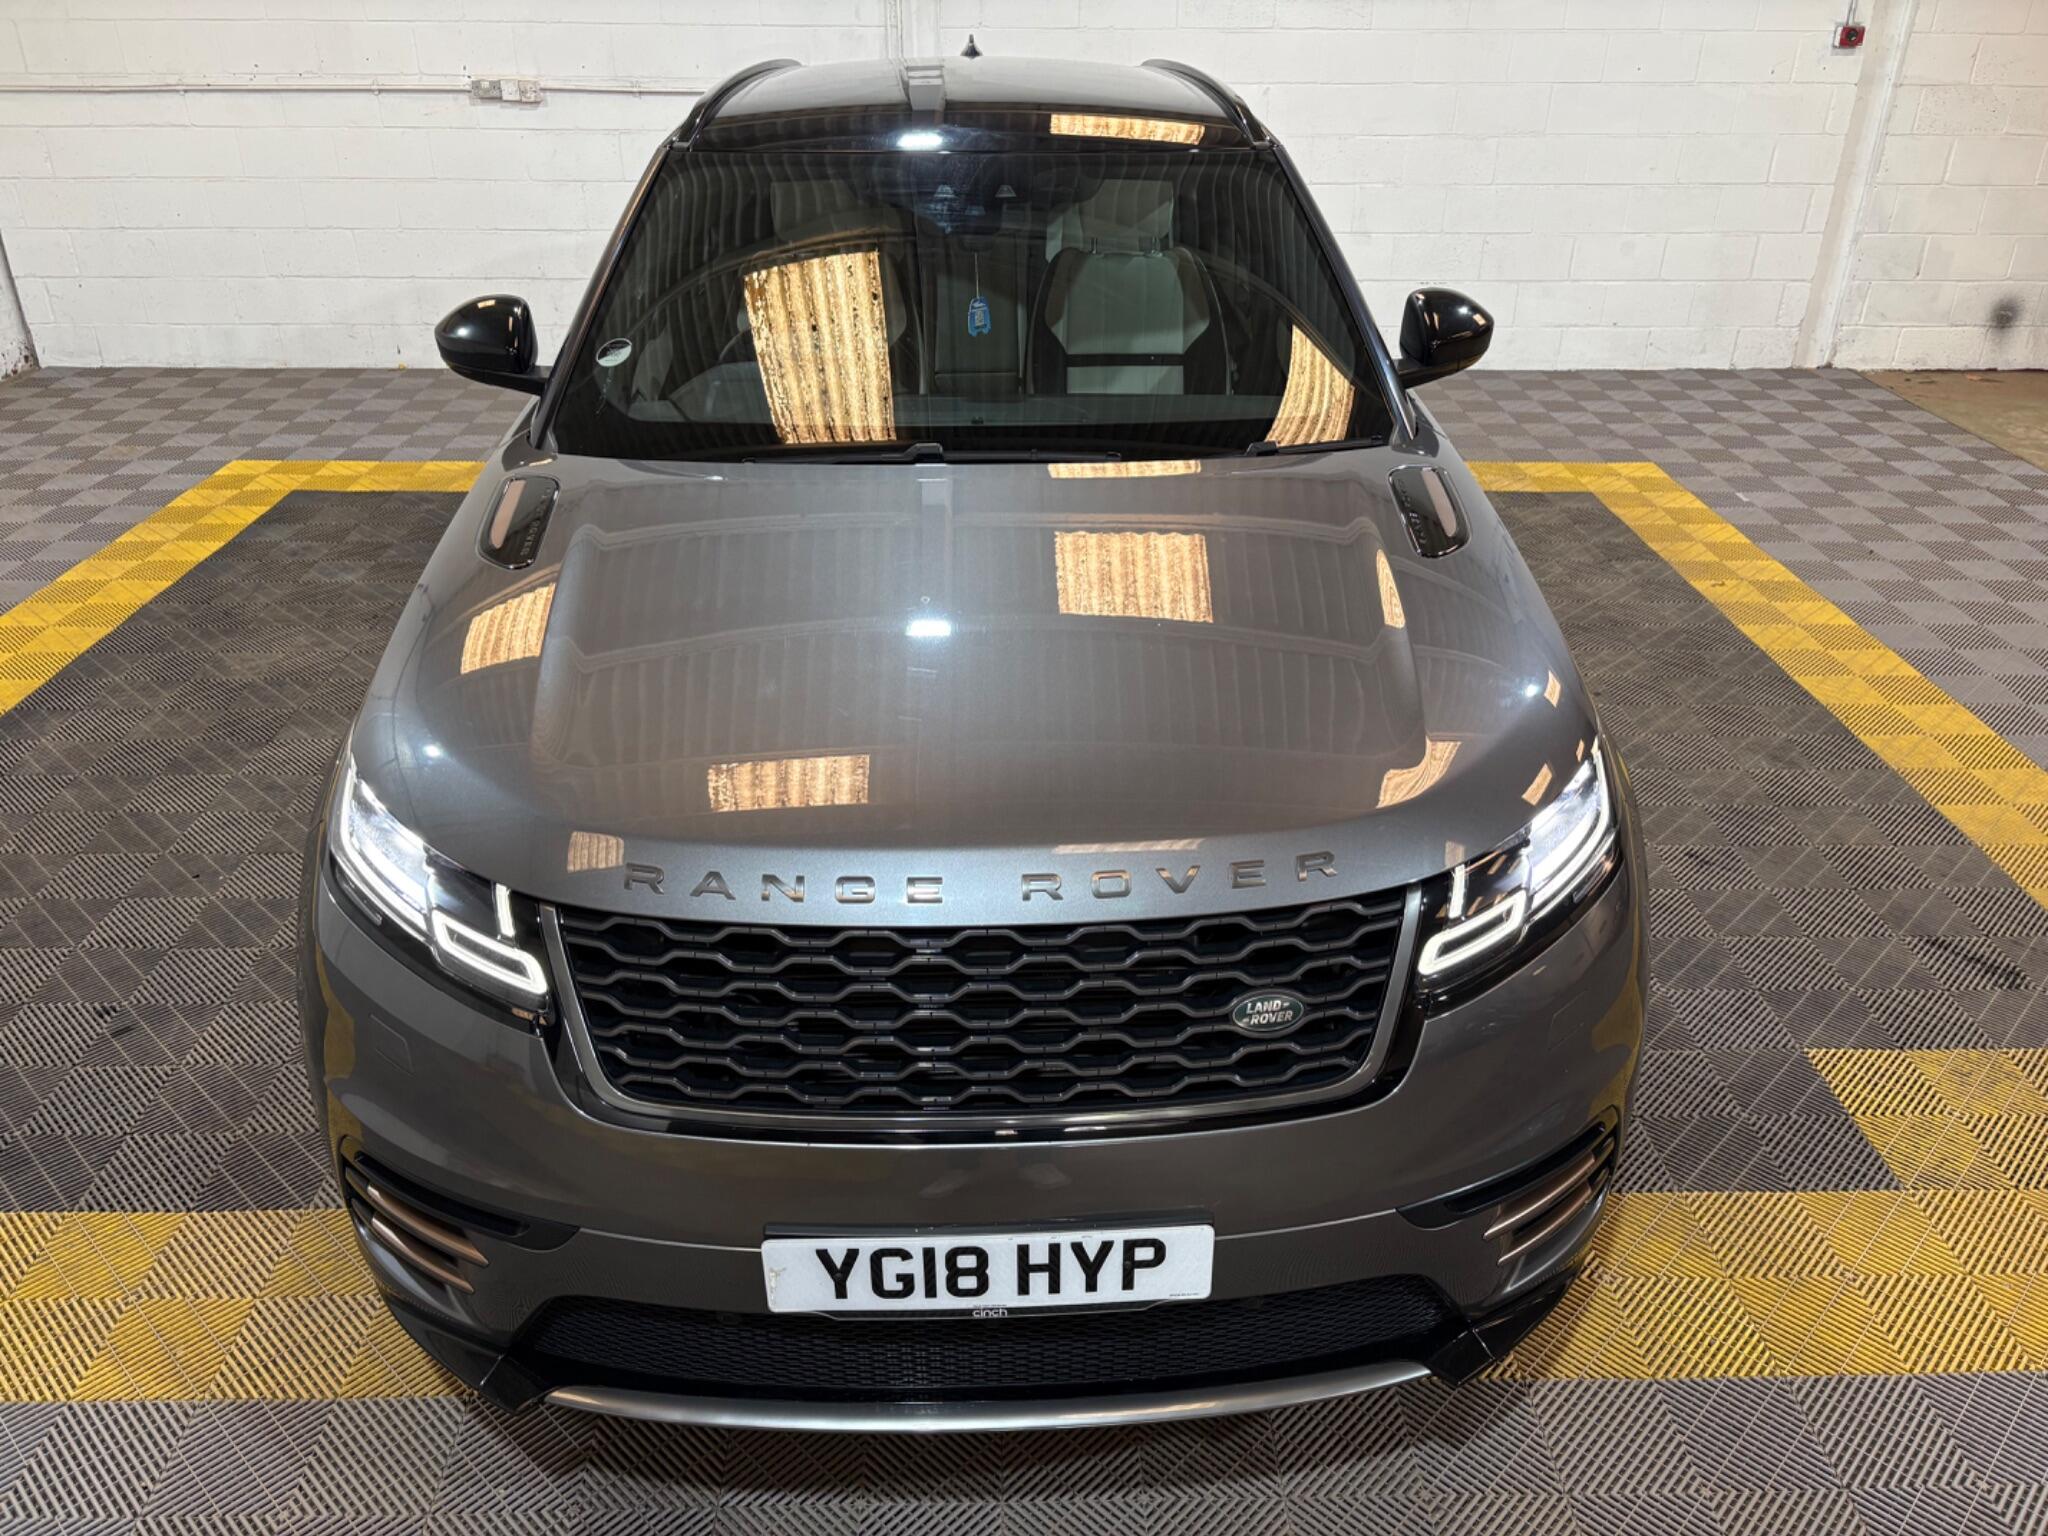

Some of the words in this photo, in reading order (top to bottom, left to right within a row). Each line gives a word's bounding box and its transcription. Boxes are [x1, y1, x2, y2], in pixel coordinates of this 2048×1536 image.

[623, 861, 944, 905] RANGE
[1020, 850, 1338, 901] ROVER
[1246, 1000, 1282, 1014] LAND
[1250, 1010, 1293, 1025] ROVER
[815, 1245, 990, 1300] YG18
[1016, 1238, 1167, 1296] HYP
[972, 1307, 1008, 1318] cinch
